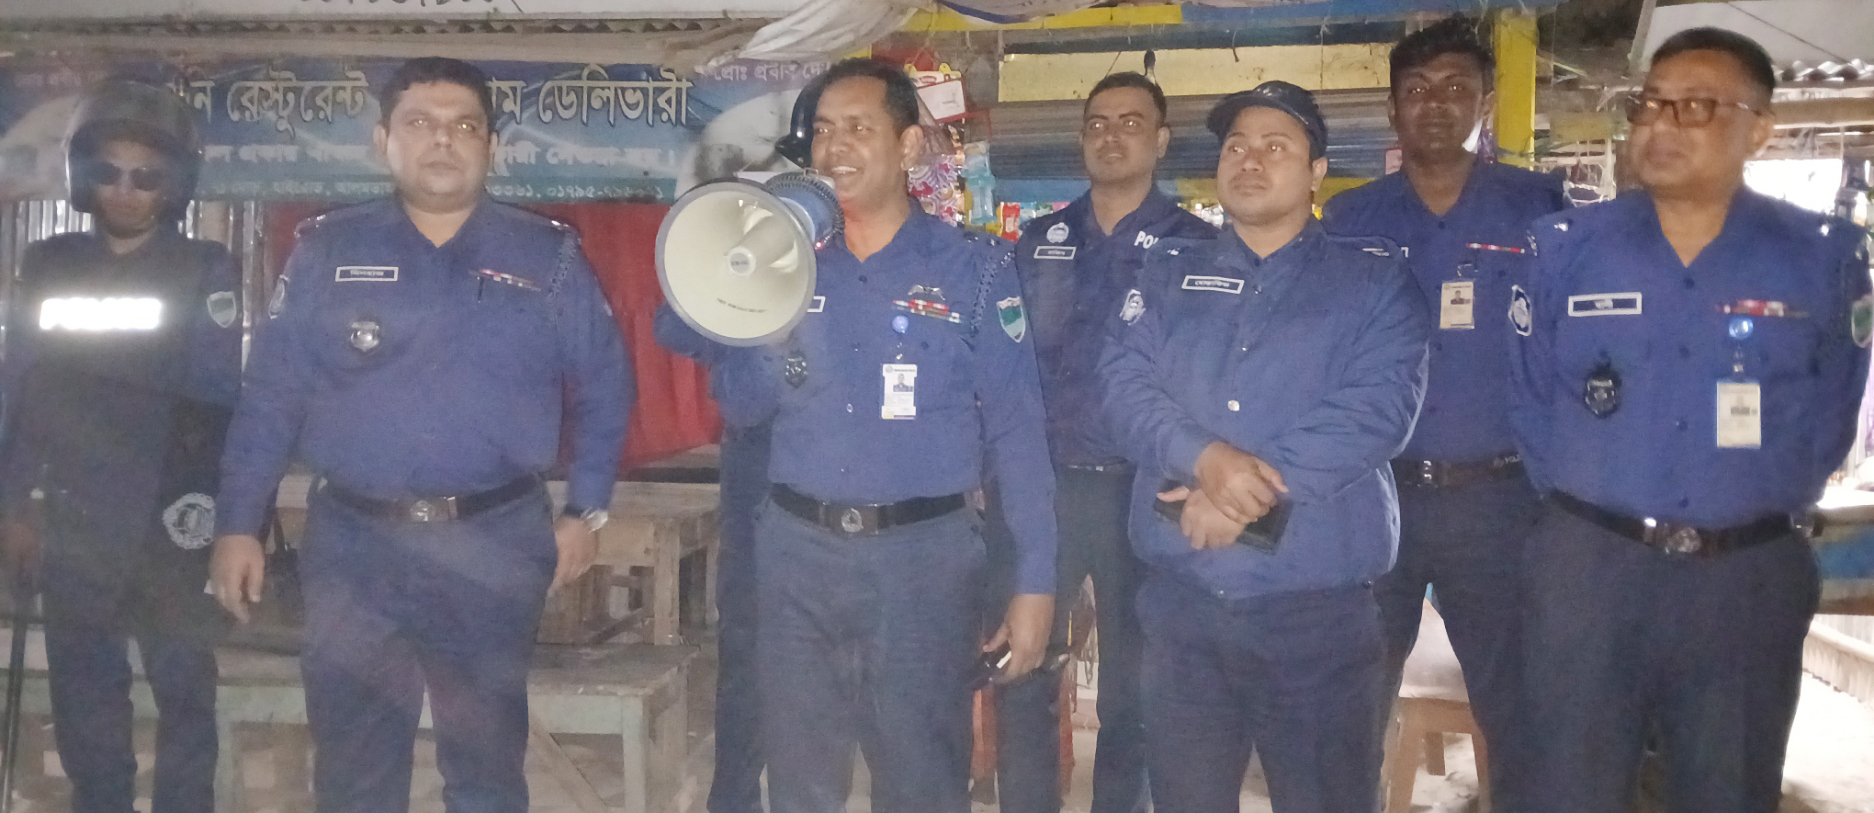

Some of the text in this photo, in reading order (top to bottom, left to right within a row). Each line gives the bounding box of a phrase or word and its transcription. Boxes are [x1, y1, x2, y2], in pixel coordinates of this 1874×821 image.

[227, 64, 370, 140] রেস্টুরেন্ট
[486, 76, 527, 125] াম
[538, 63, 694, 127] ডেলিভারী
